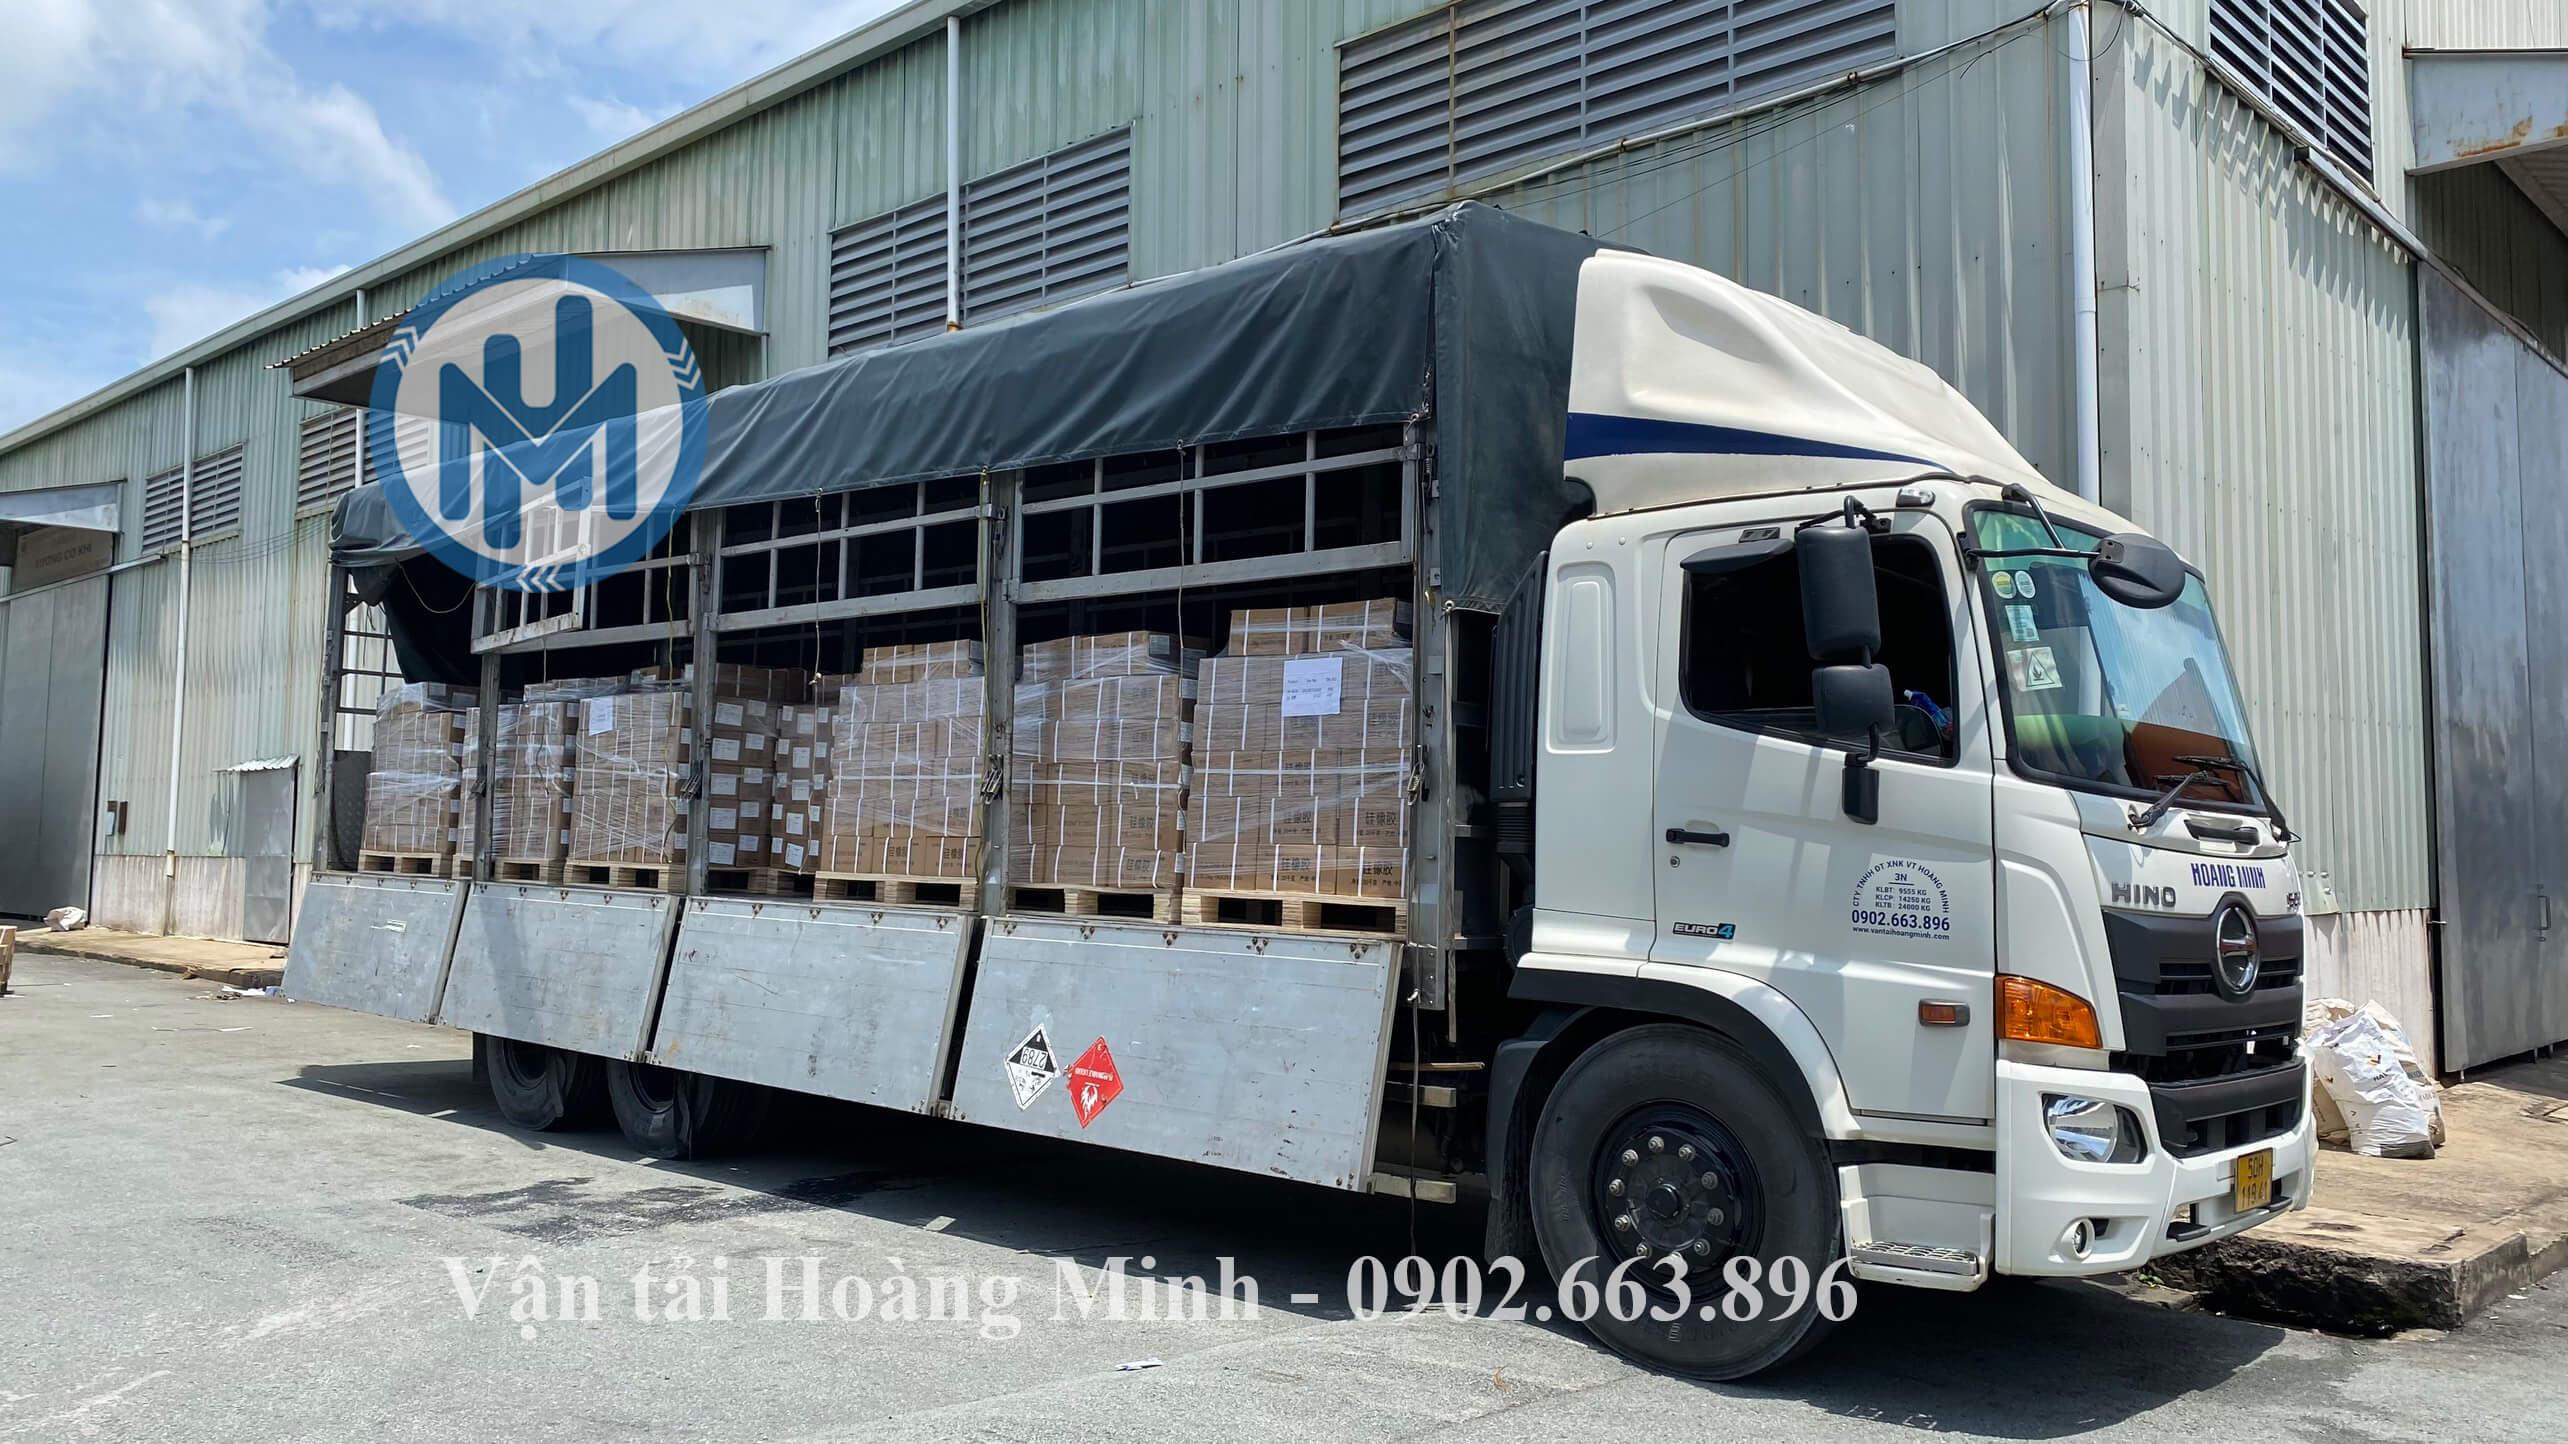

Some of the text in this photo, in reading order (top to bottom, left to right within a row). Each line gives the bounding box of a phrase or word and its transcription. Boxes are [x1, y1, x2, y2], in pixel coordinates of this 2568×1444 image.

[1886, 860, 1904, 868] XNK
[1906, 860, 1917, 869] VT
[1856, 870, 1875, 889] TNHH
[1894, 873, 1907, 881] 3N
[1852, 891, 1861, 907] CTY
[1917, 888, 1927, 896] KG
[2112, 883, 2176, 907] HINO
[1939, 889, 1950, 913] MINH
[1851, 909, 1950, 931] 0902.663.896
[1852, 926, 1950, 940] www.vantaihoangminh.com
